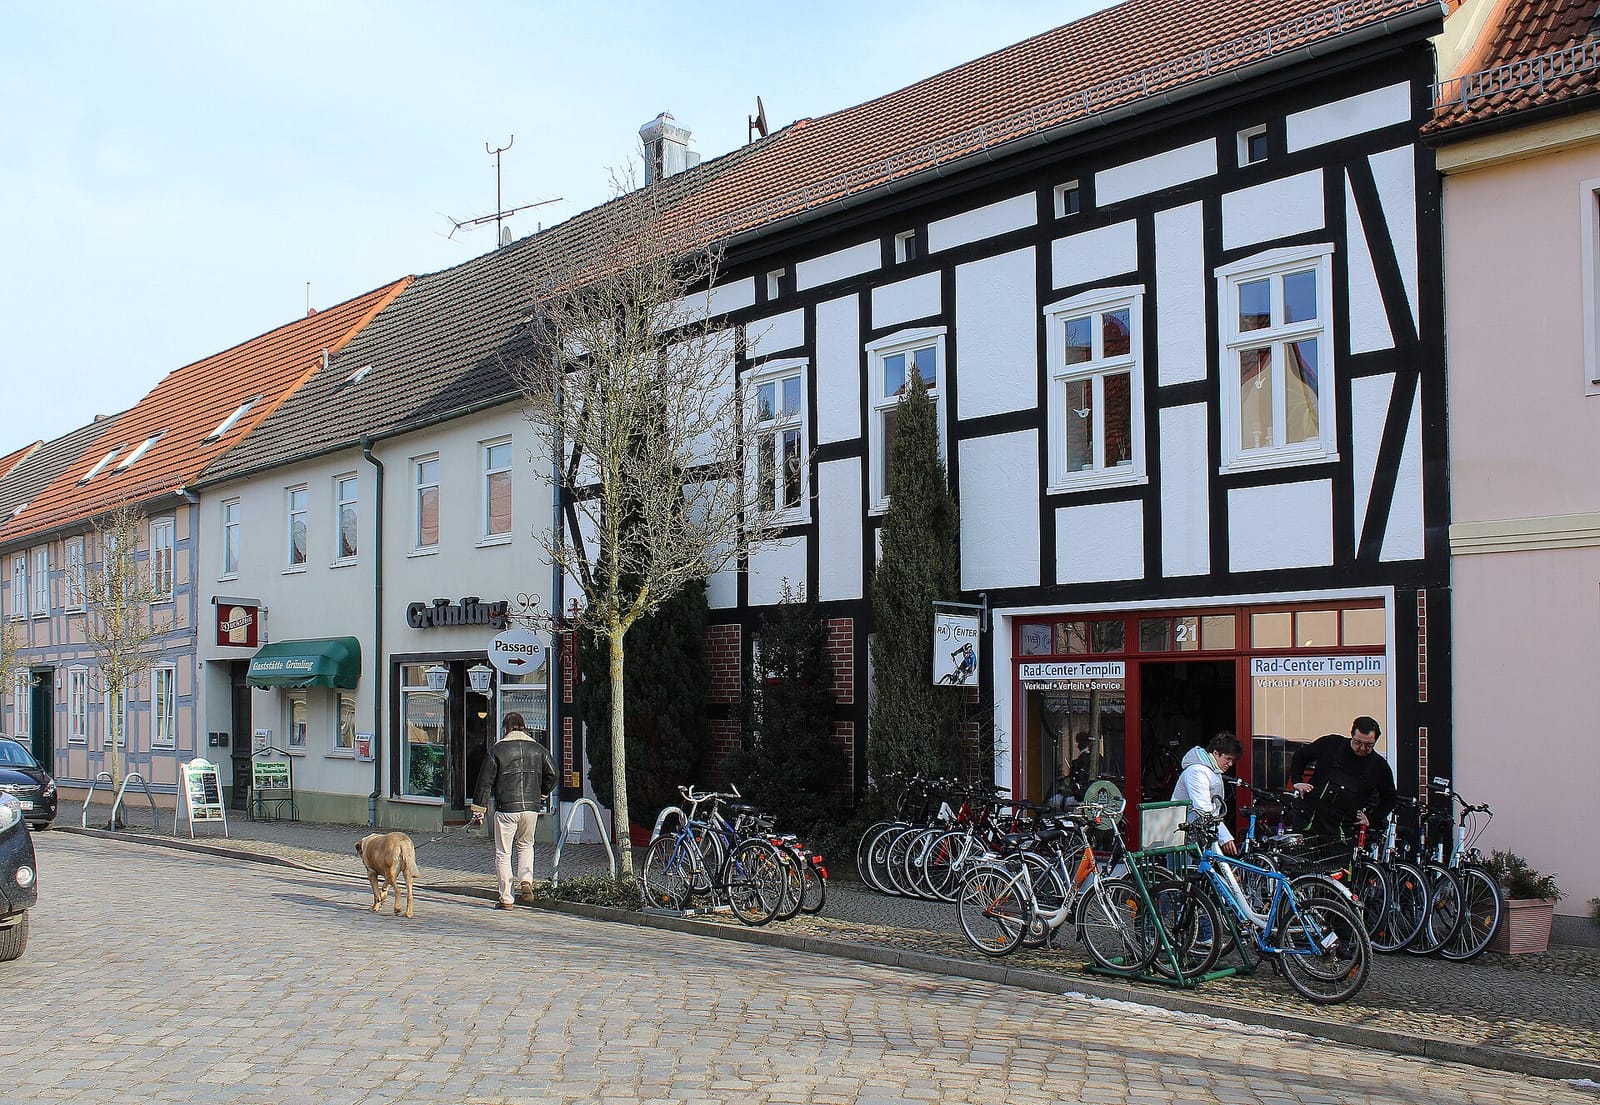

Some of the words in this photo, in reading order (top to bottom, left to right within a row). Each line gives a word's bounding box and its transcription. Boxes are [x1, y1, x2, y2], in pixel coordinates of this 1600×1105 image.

[407, 597, 508, 629] Grünling
[1176, 624, 1197, 642] 21
[495, 640, 540, 656] Passage
[253, 660, 283, 671] Gaststätte
[1023, 664, 1078, 677] Rad-Center
[1080, 662, 1121, 678] Templin
[1255, 658, 1325, 672] Rad-Center
[1327, 656, 1381, 673] Templin
[1024, 681, 1052, 690] Verkauf
[1058, 681, 1085, 690] Verleih
[1091, 681, 1121, 690] Service
[1257, 678, 1293, 688] Verkauf
[1301, 678, 1334, 688] Verleih
[1342, 677, 1382, 687] Service
